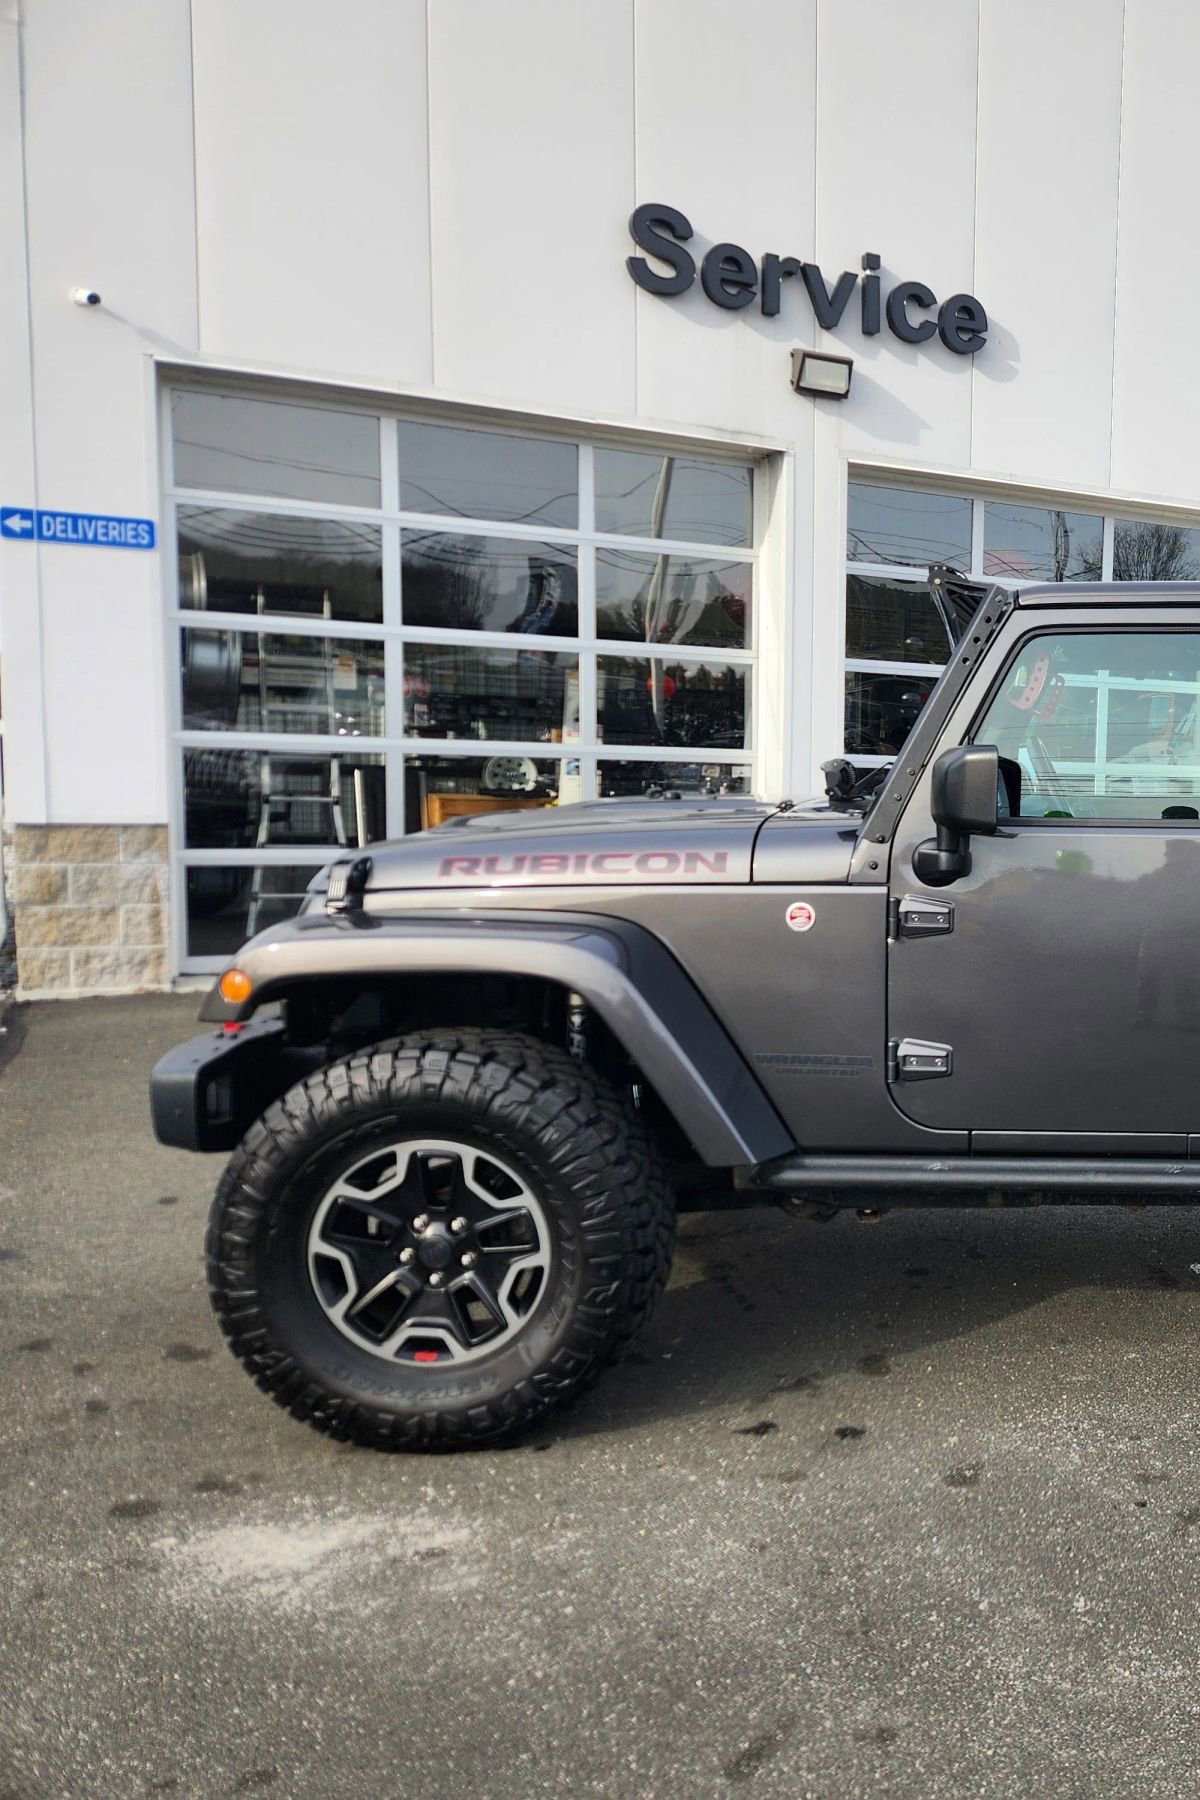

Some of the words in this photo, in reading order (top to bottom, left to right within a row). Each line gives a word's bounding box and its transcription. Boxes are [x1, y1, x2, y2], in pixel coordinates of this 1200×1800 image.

[626, 203, 988, 354] Service
[41, 515, 150, 545] DELIVERIES
[438, 852, 728, 877] RUBICON
